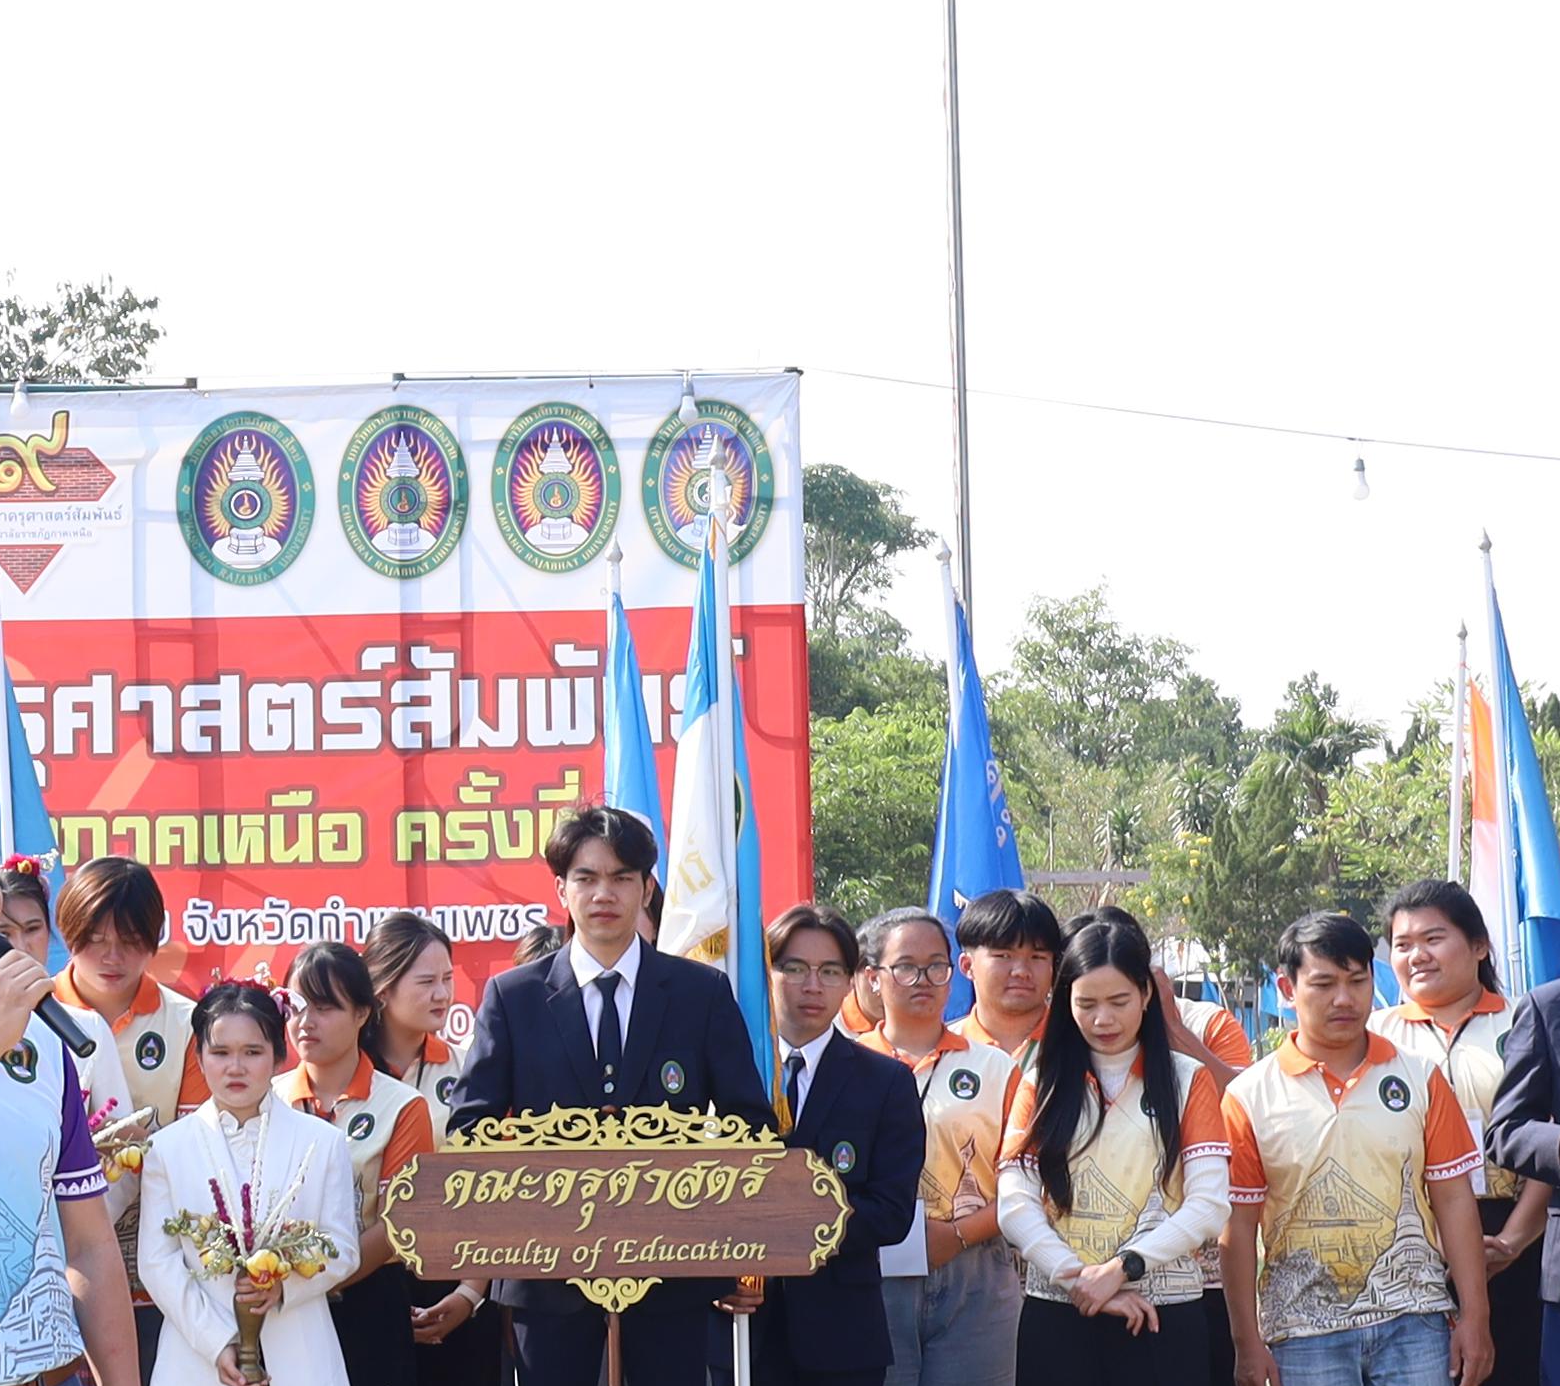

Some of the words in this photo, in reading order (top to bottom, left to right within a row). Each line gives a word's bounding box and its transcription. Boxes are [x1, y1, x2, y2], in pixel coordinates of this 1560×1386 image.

[442, 1150, 788, 1233] คณะครุศาสตร์
[450, 1238, 562, 1273] Faculty
[572, 1237, 609, 1273] of
[614, 1235, 767, 1264] Education
